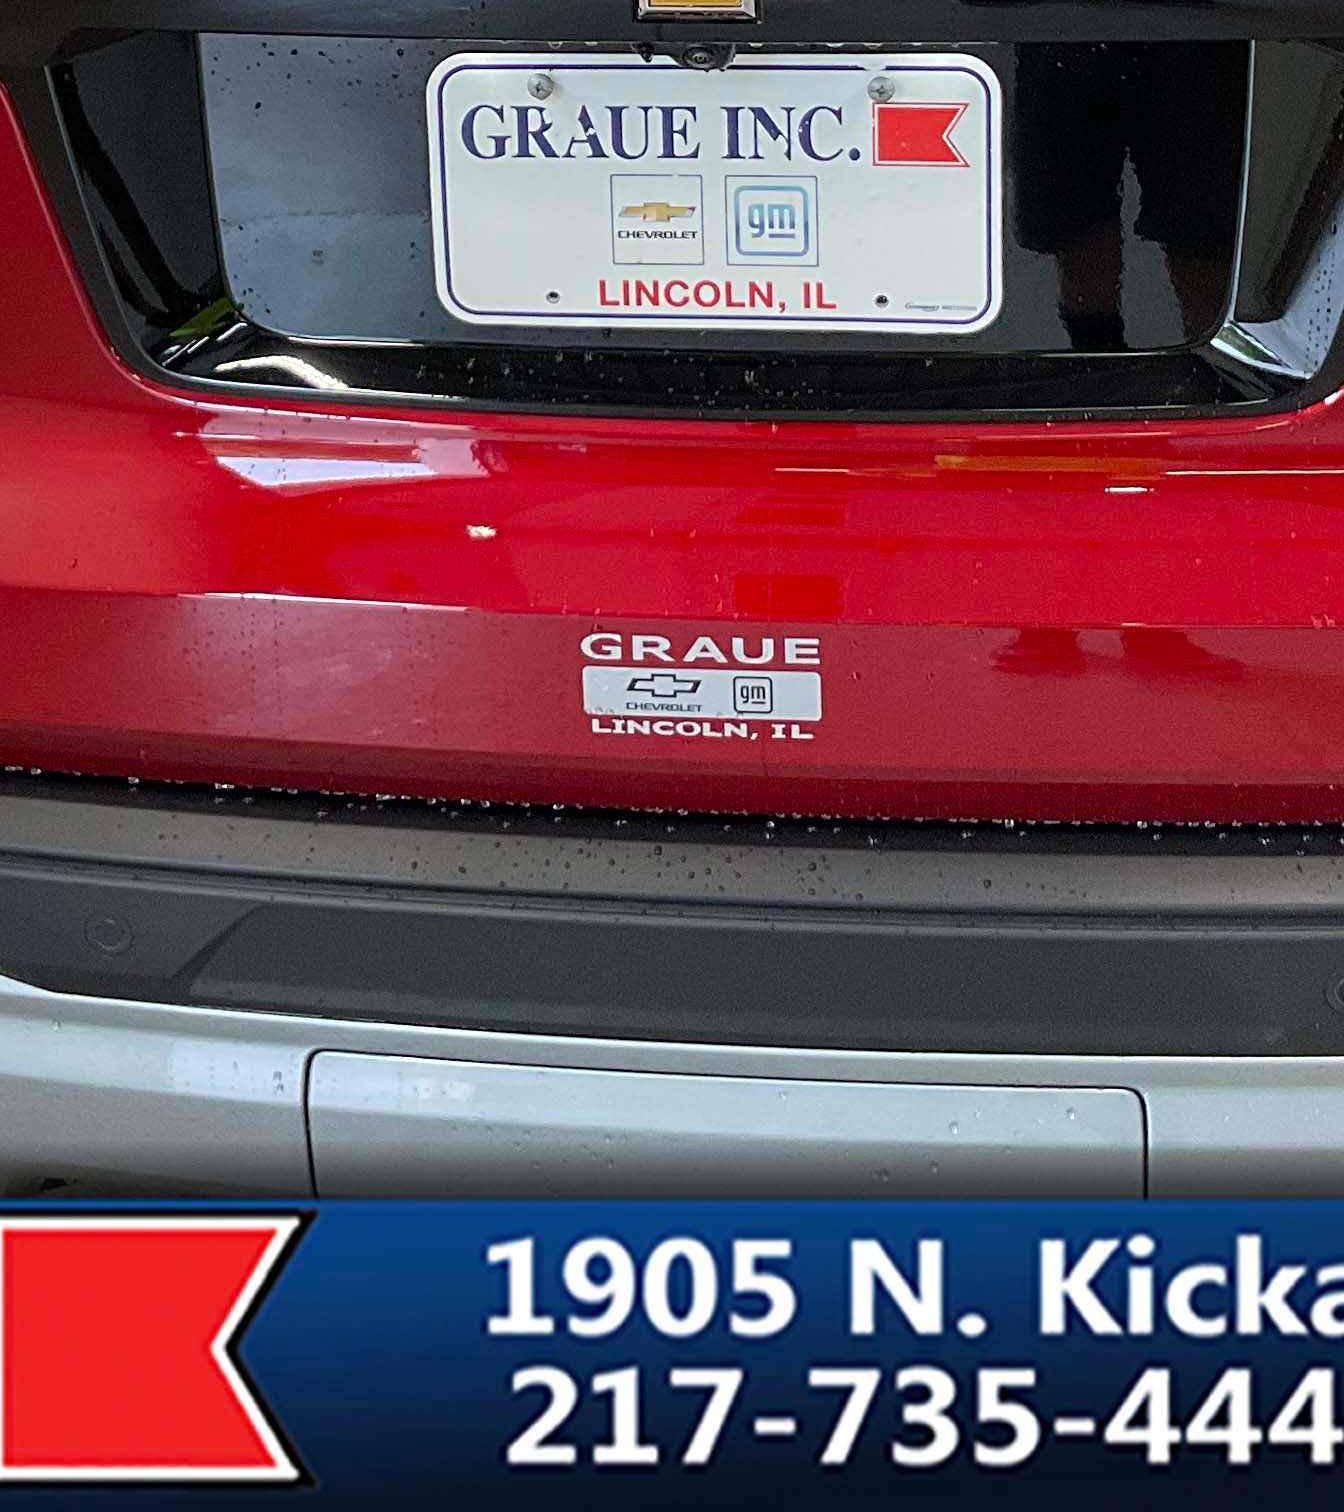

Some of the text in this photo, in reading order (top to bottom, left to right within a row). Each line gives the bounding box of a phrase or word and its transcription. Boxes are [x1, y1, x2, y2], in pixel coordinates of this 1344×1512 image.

[460, 103, 861, 162] GRAUE INC.
[617, 230, 698, 240] CHEVROLET
[748, 203, 796, 239] gm
[598, 279, 838, 314] LINCOLN, IL
[579, 632, 822, 665] GRAUE
[625, 701, 703, 713] CHEVROLET
[740, 685, 767, 705] gm
[591, 718, 815, 741] LINCOLN, IL
